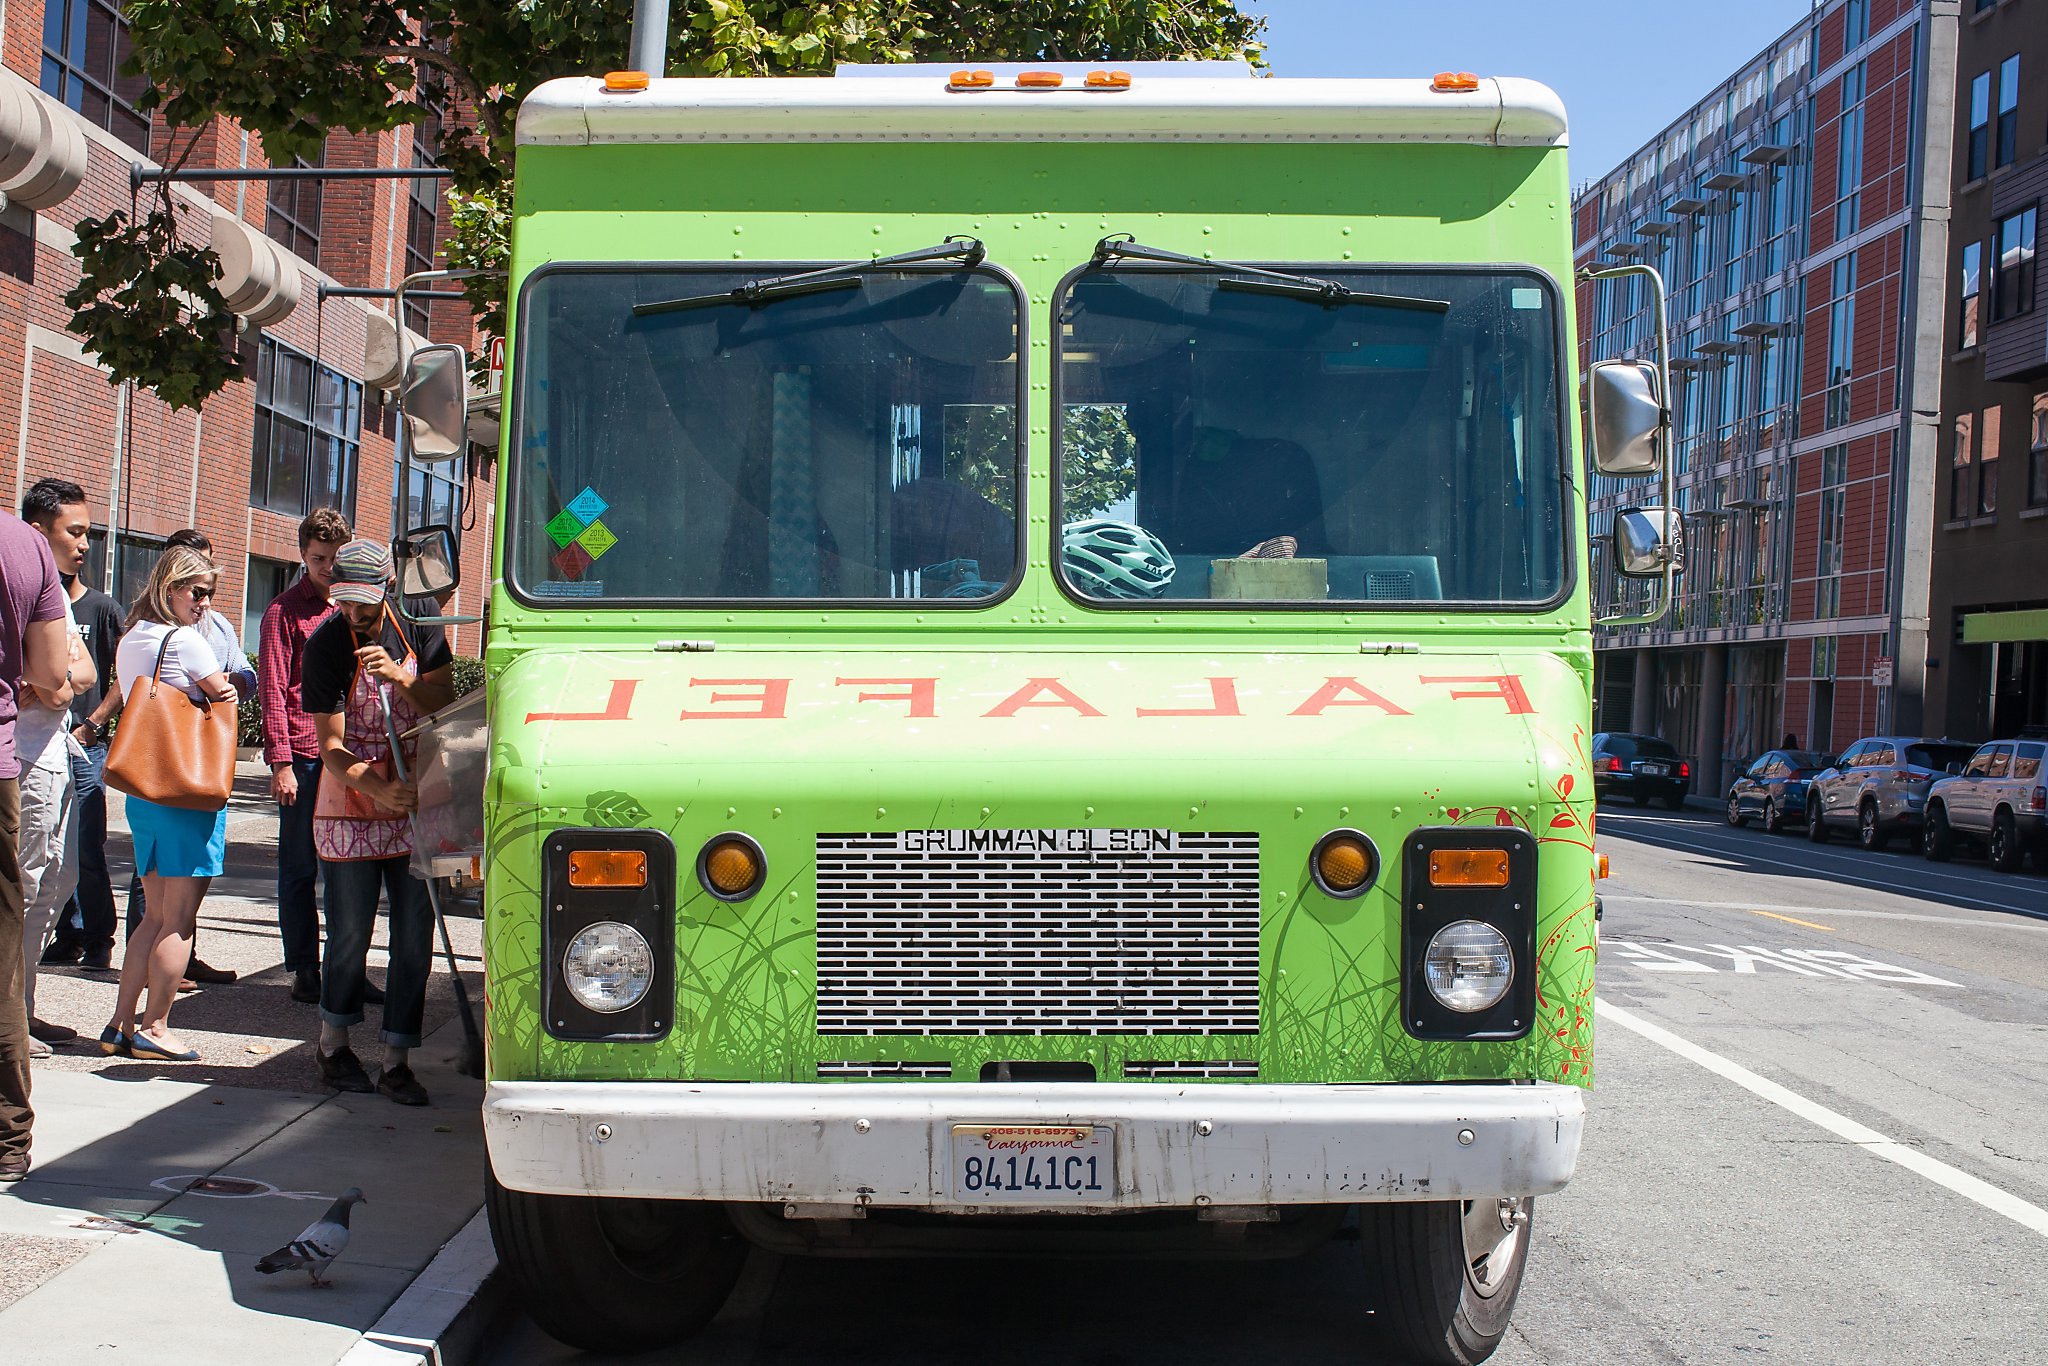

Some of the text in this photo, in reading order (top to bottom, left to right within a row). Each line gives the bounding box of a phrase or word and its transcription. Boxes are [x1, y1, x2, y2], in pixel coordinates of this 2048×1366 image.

[581, 497, 596, 505] 2014
[557, 518, 572, 526] 2012
[905, 829, 1171, 851] GRUMMAN OLSON
[989, 1128, 1077, 1136] 408-516-6973
[965, 1156, 1102, 1191] 84141C1
